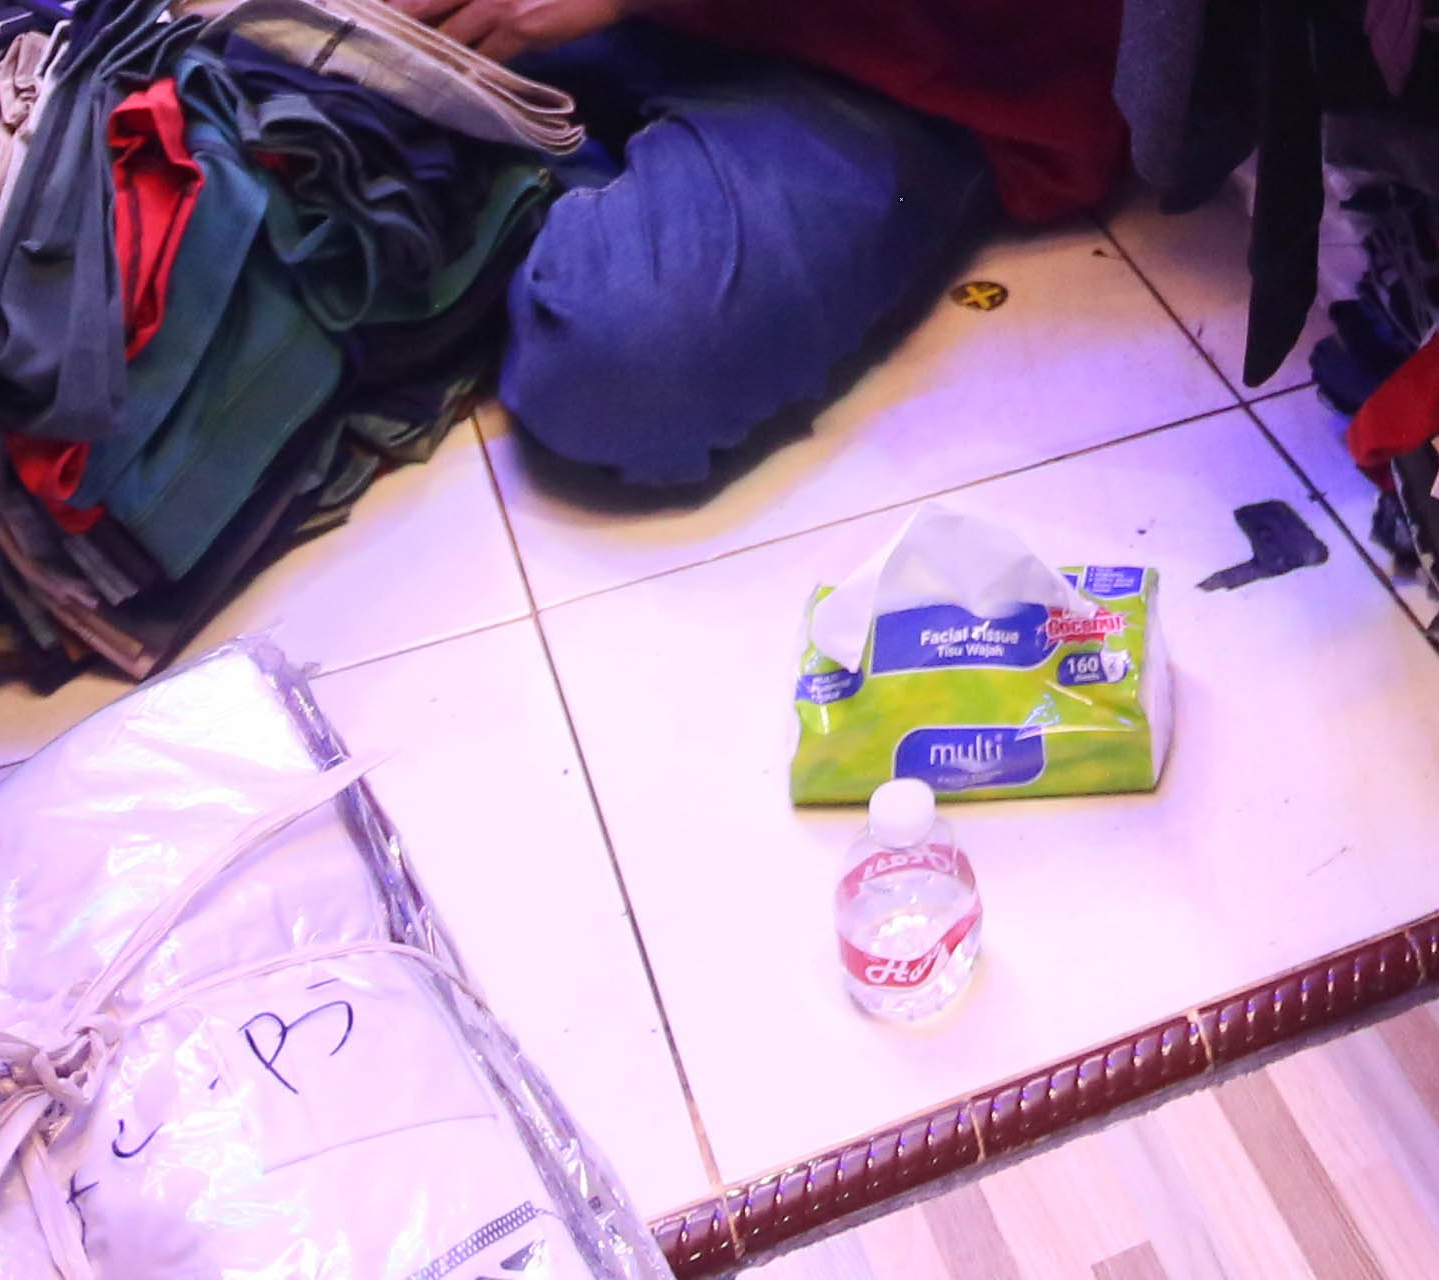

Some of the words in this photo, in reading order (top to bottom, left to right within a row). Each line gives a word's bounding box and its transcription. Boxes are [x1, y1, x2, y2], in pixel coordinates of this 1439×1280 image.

[919, 626, 969, 647] Facial
[937, 645, 963, 659] Tisu
[965, 643, 1005, 659] Wajah
[1066, 656, 1099, 675] 160
[929, 733, 1003, 766] multi
